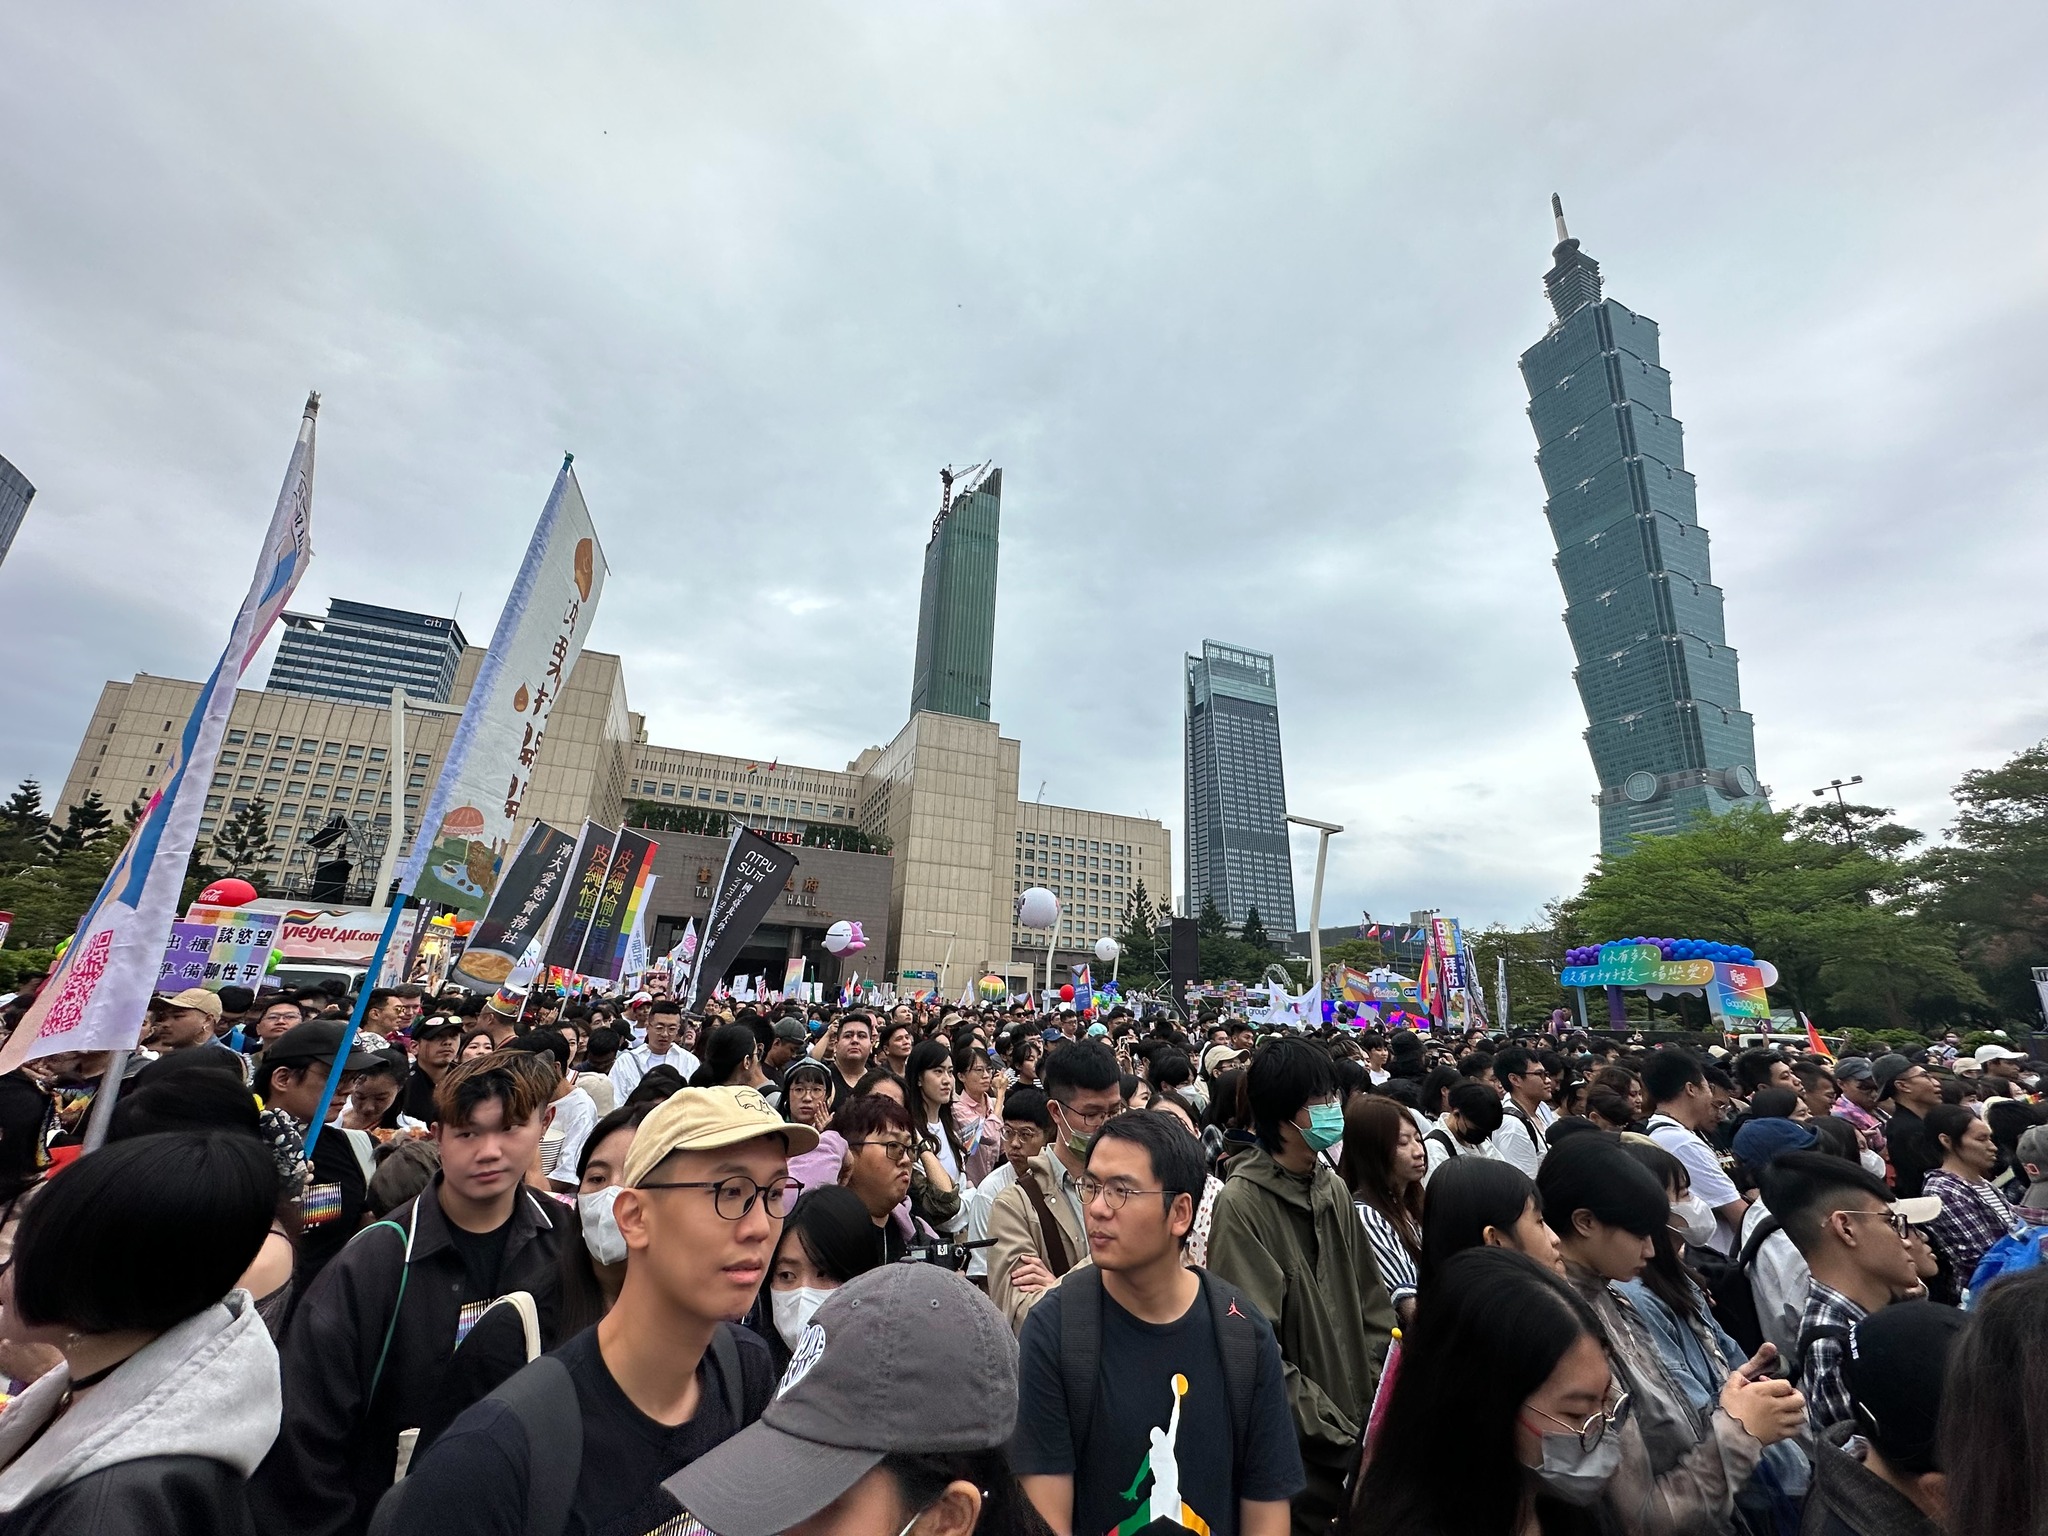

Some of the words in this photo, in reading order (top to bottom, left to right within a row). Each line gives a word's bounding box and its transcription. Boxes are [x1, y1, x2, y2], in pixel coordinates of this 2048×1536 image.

[424, 619, 443, 628] citi
[745, 850, 777, 873] NTPU
[787, 893, 817, 907] HALL
[1436, 921, 1450, 936] Bi
